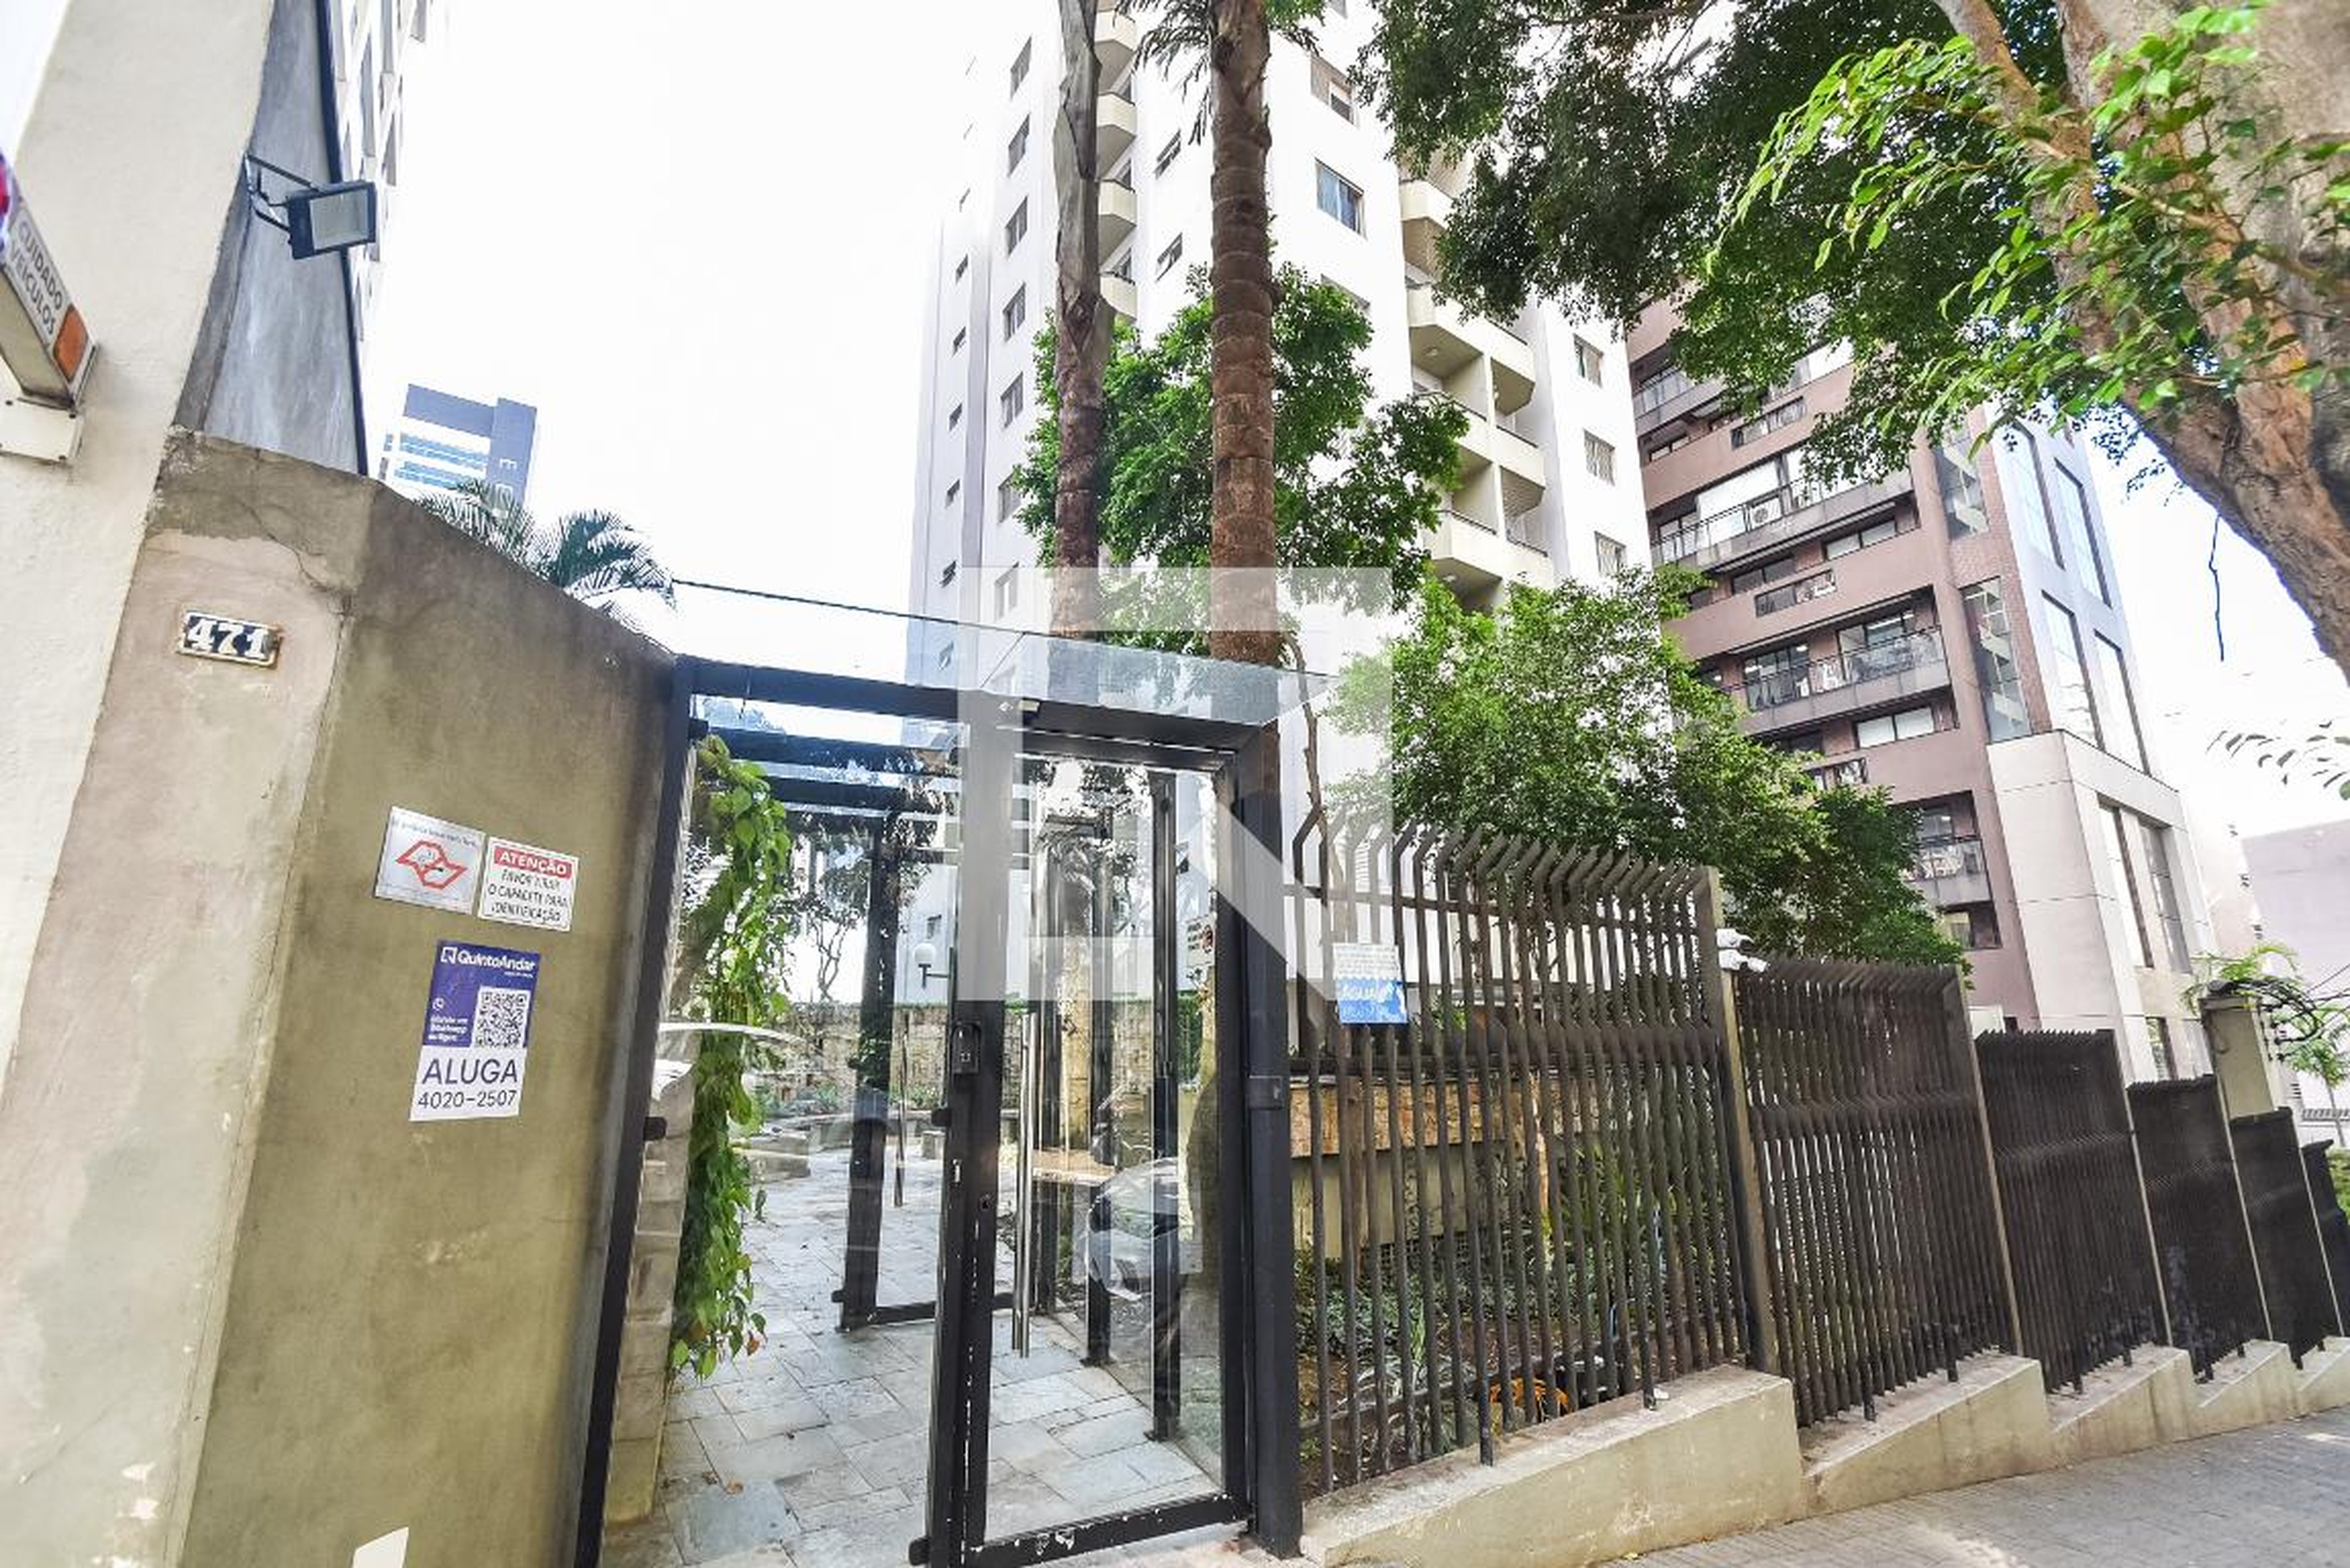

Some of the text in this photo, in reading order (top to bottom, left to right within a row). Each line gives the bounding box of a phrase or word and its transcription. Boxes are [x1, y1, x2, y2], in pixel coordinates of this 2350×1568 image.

[18, 220, 62, 310] CUIDADO
[500, 851, 567, 875] ATENÇÃO
[488, 884, 496, 895] O
[458, 950, 535, 972] QuintoAndar
[422, 1058, 518, 1085] ALUGA
[418, 1089, 517, 1110] 4020-2507
